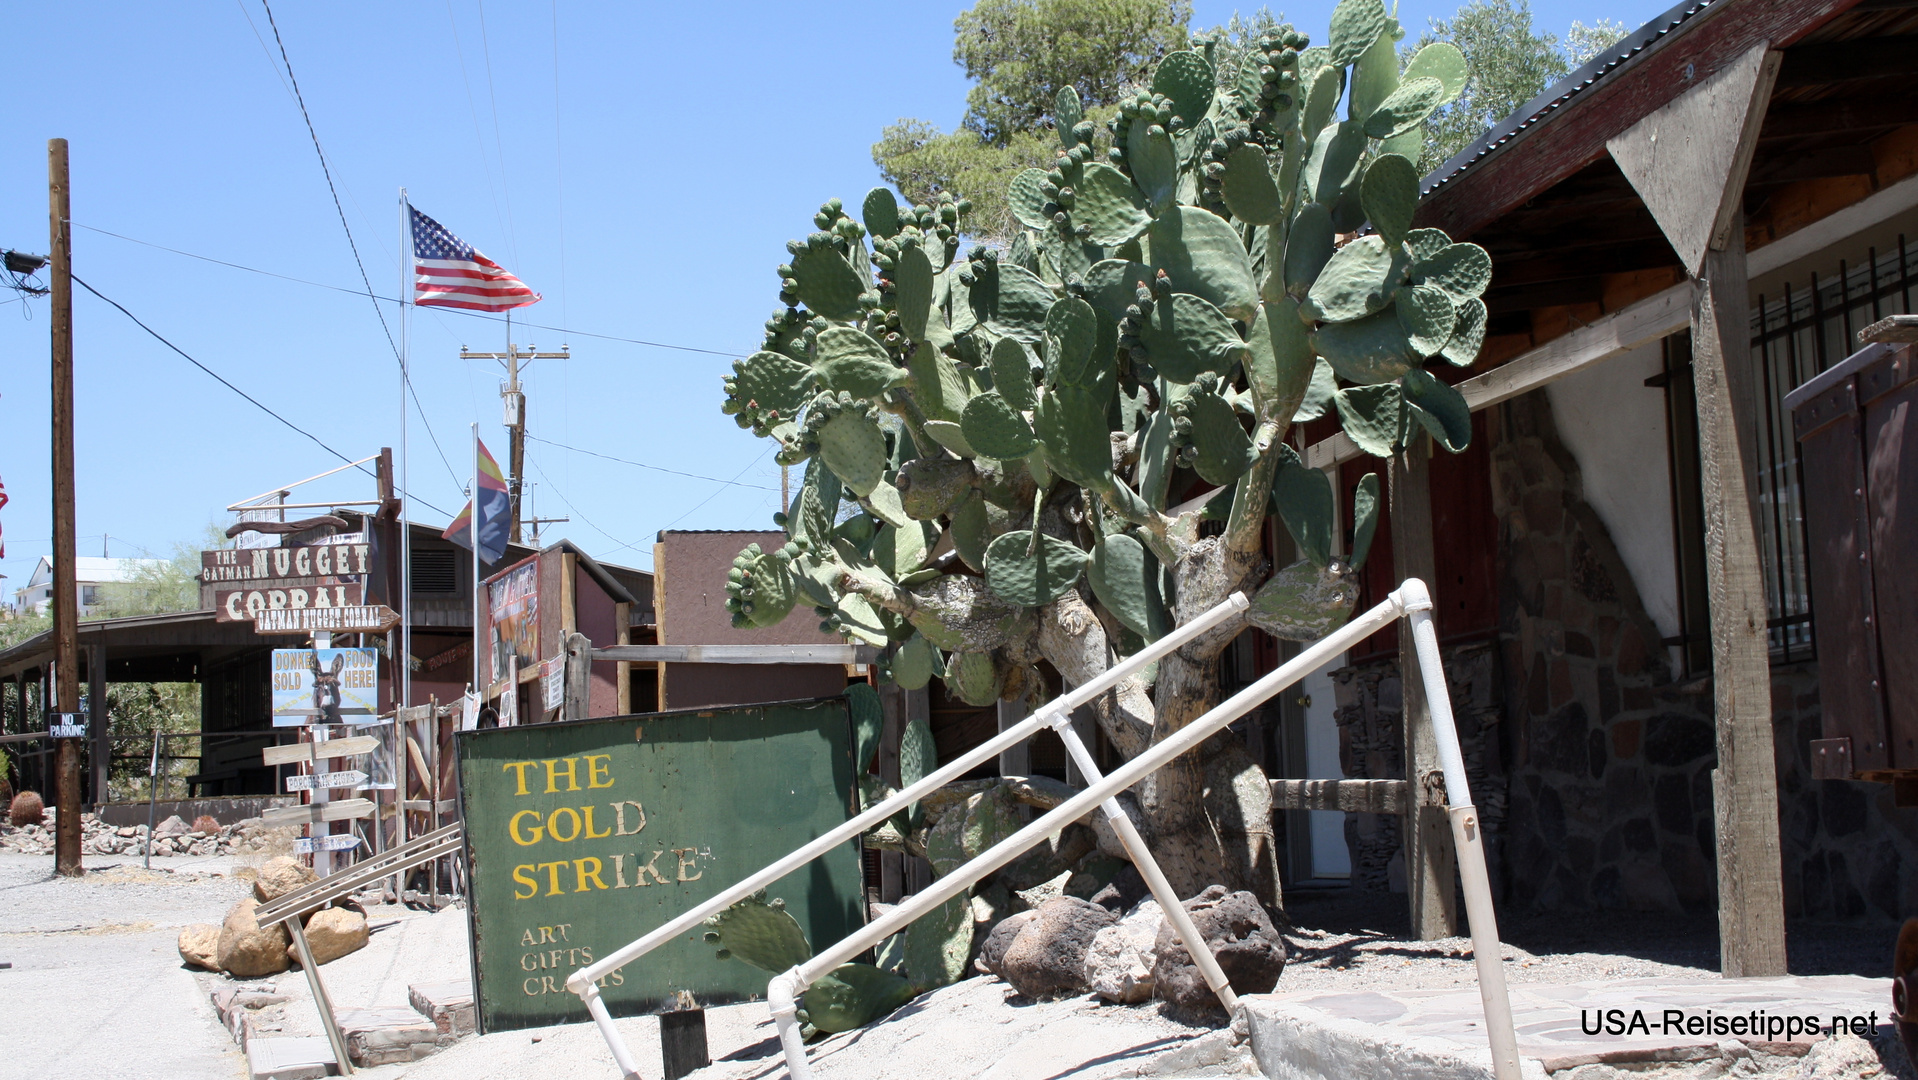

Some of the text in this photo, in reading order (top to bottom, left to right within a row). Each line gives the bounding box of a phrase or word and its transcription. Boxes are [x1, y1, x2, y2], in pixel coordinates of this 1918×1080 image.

[216, 551, 237, 565] THE
[252, 545, 369, 579] NUGGET
[203, 565, 251, 581] OATMAN
[225, 586, 353, 620] CORRAL
[258, 606, 381, 631] OATMAN NUGGET CORRAL
[345, 650, 374, 668] FOOD
[274, 669, 376, 691] SOLD HERE!
[51, 724, 85, 736] PARKING
[62, 714, 74, 725] NO
[502, 754, 615, 796] THE
[509, 800, 647, 847] GOLD
[512, 847, 703, 900] STRIKE
[520, 923, 572, 947] ART
[520, 946, 594, 972] GIFTS
[523, 967, 625, 996] CRS
